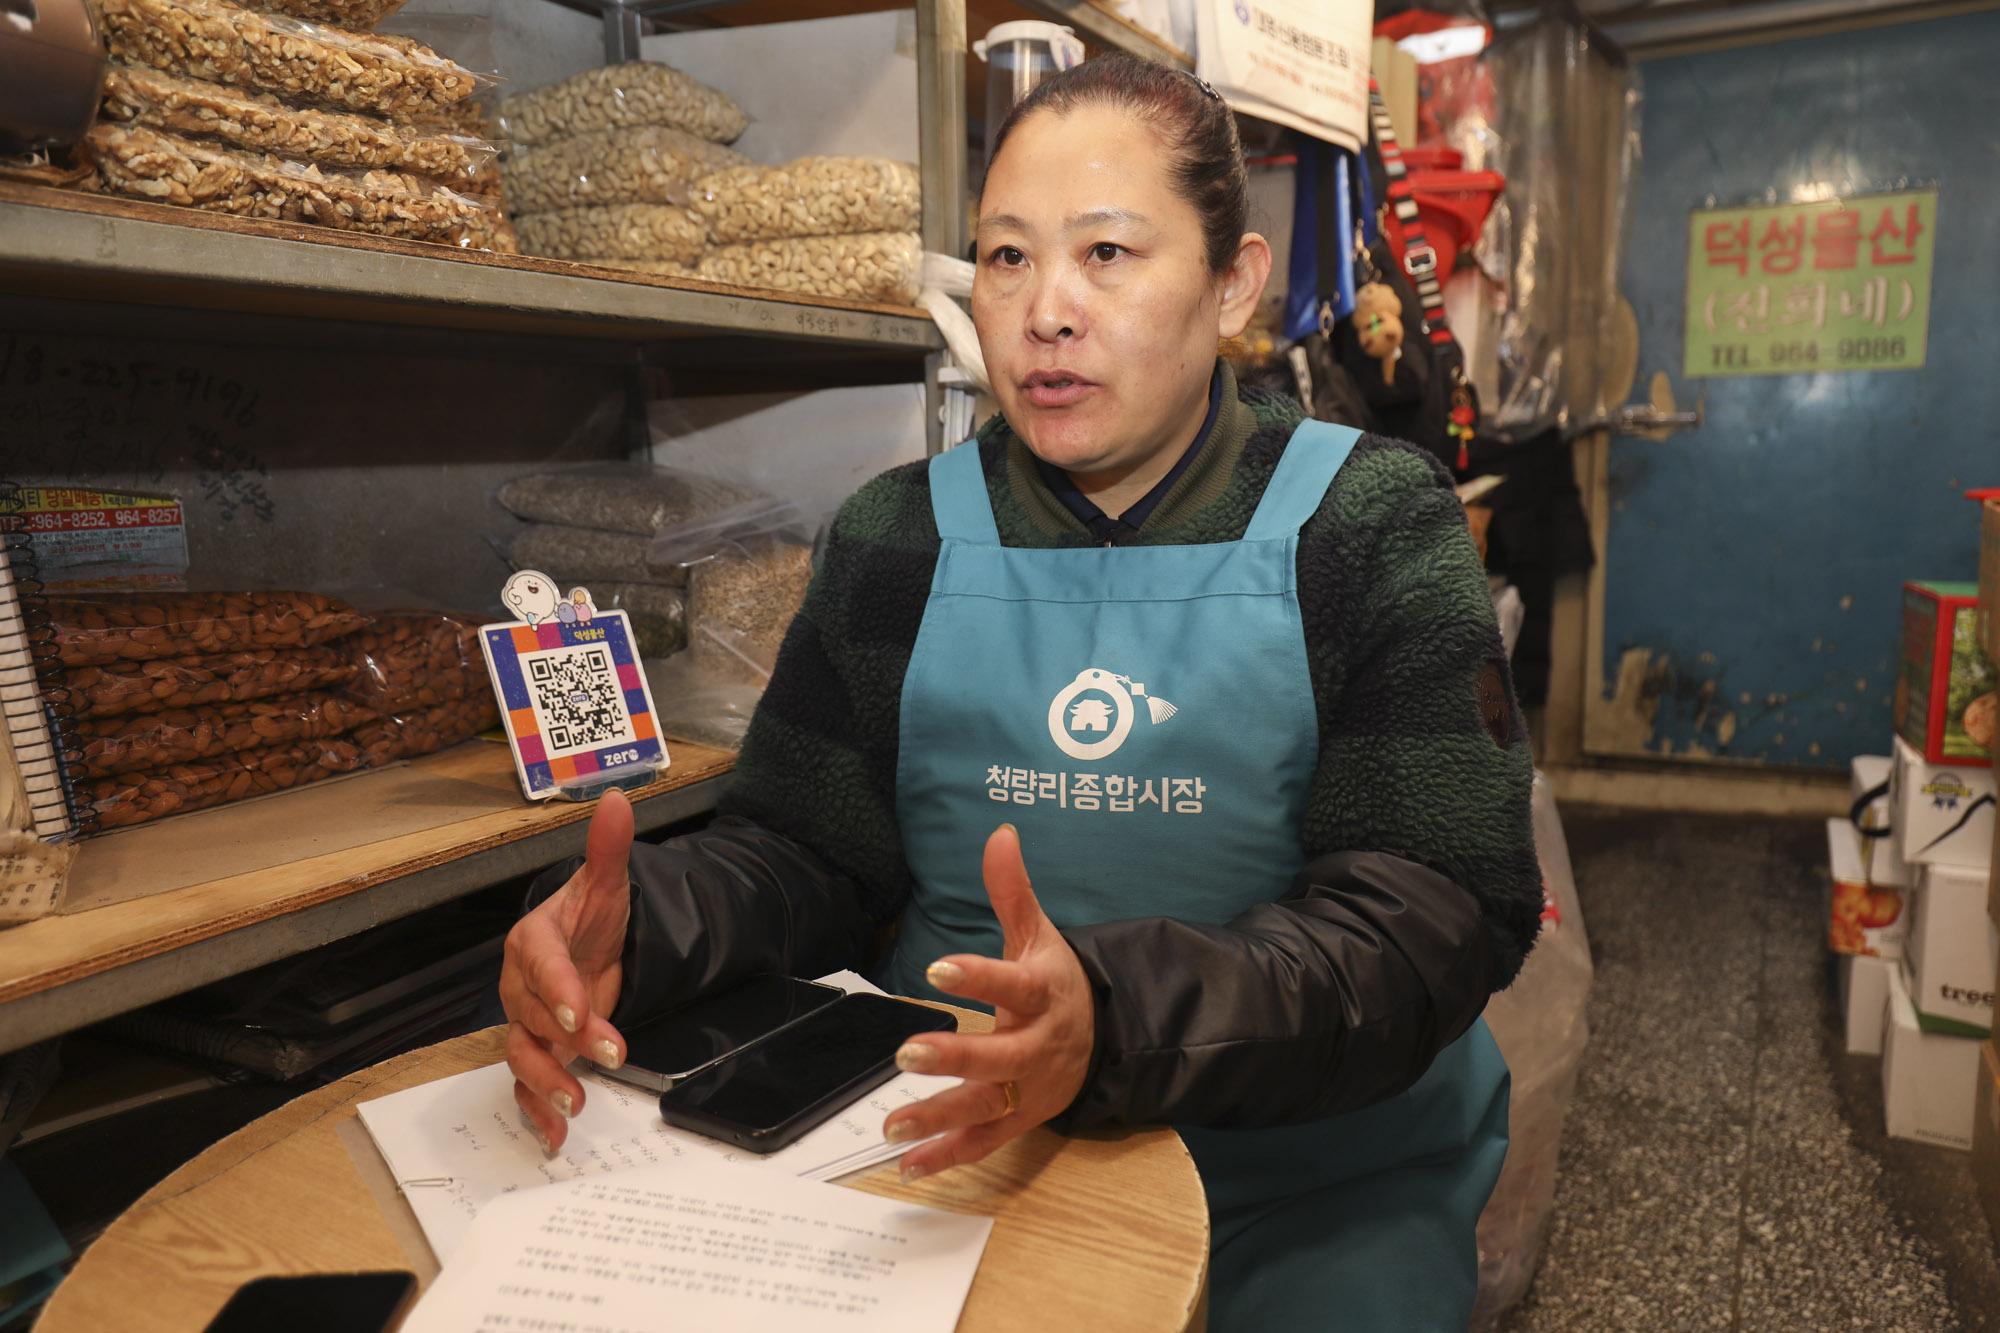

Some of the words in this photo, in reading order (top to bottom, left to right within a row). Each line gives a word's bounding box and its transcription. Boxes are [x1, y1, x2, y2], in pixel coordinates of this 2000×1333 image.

[1704, 203, 1924, 277] 덕성물산
[115, 508, 179, 525] 964-8257
[573, 627, 606, 641] 덕성물산
[604, 749, 639, 767] zero
[985, 765, 1206, 814] 청량리종합시장
